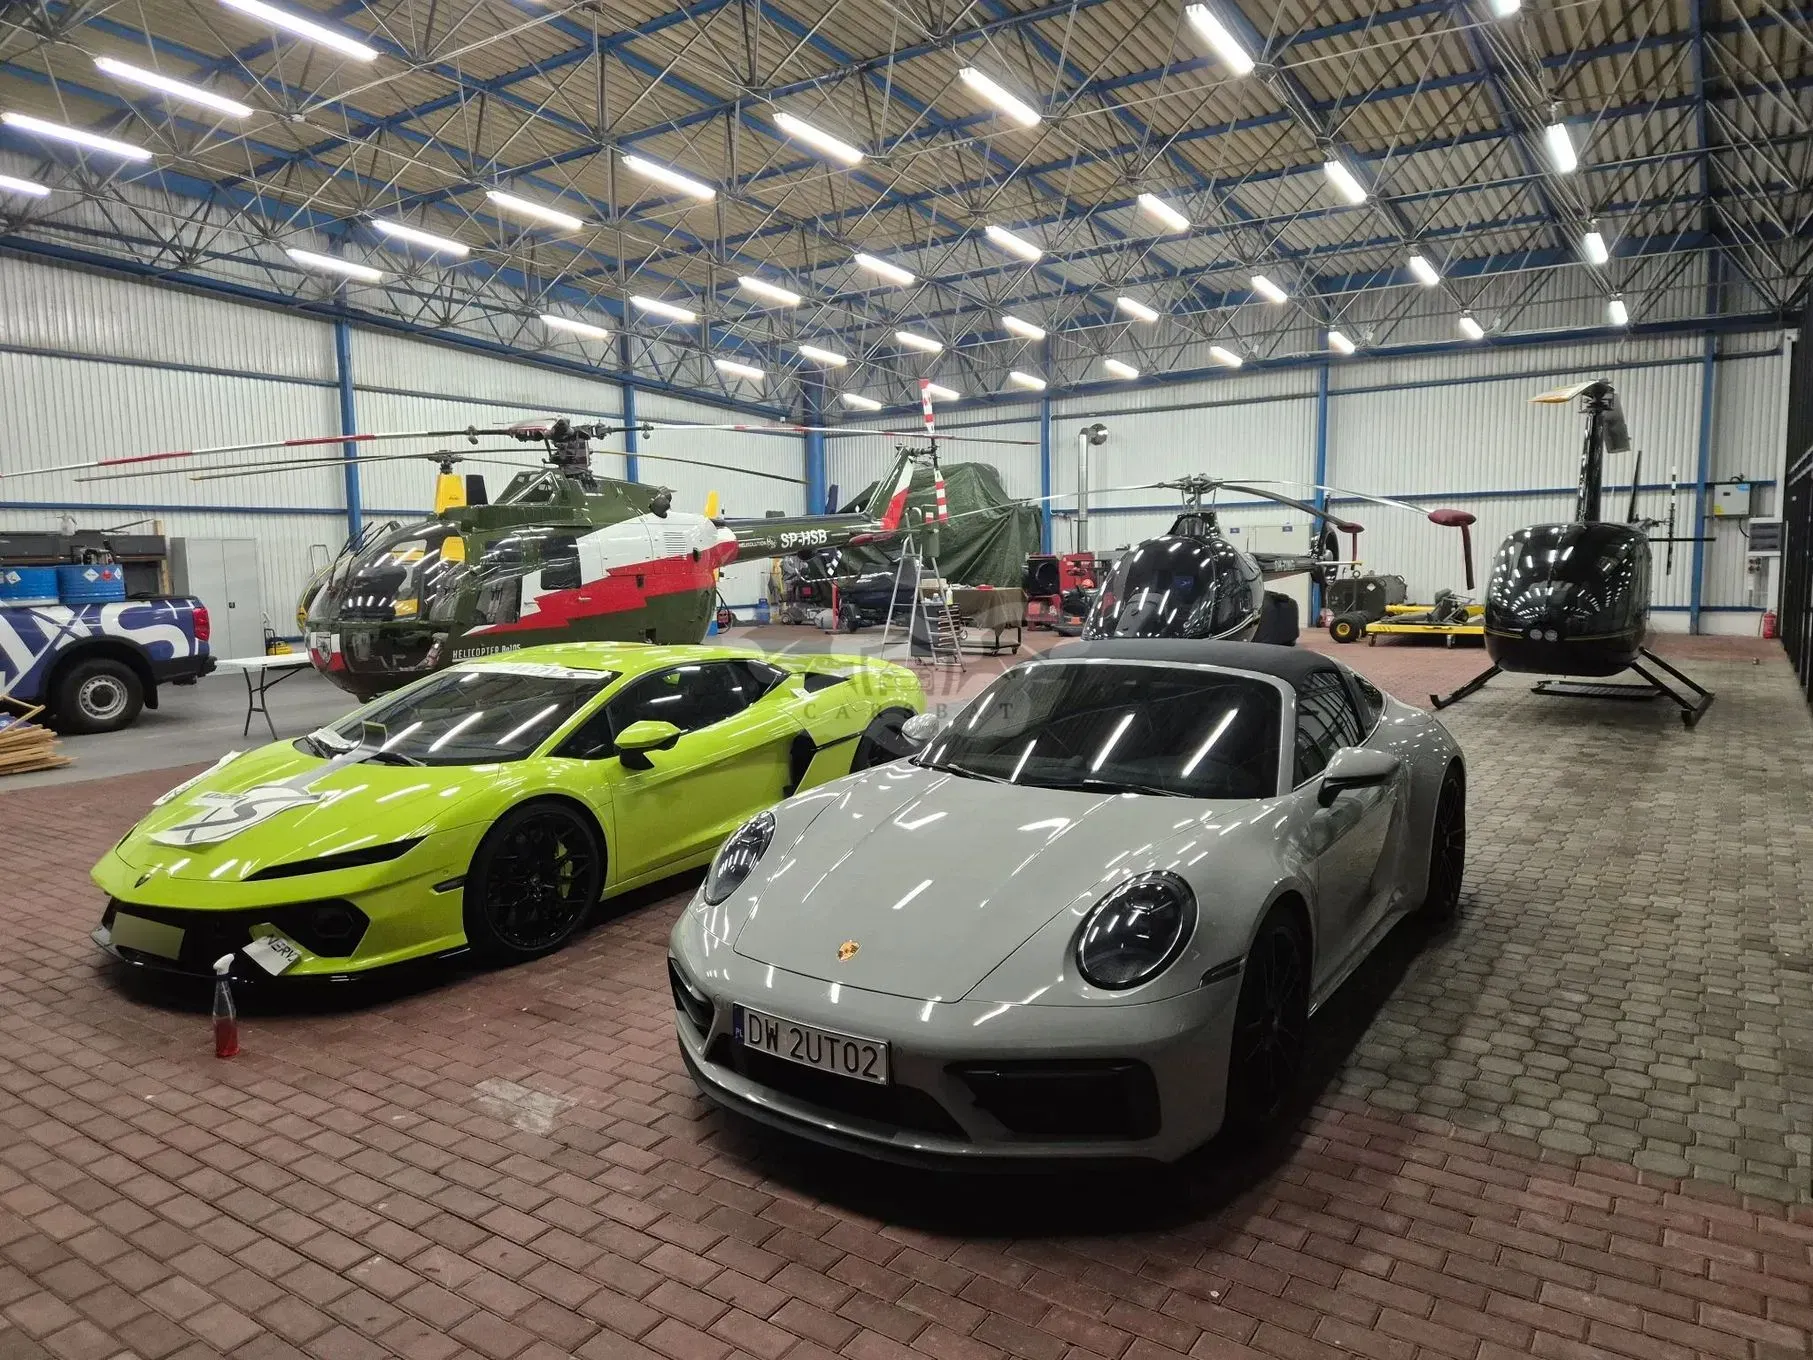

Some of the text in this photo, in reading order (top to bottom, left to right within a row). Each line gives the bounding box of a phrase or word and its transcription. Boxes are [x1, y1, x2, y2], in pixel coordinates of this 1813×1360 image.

[780, 529, 827, 548] SP-HSB
[452, 646, 499, 659] HELICOPTER
[749, 1013, 878, 1079] DW 2UT02
